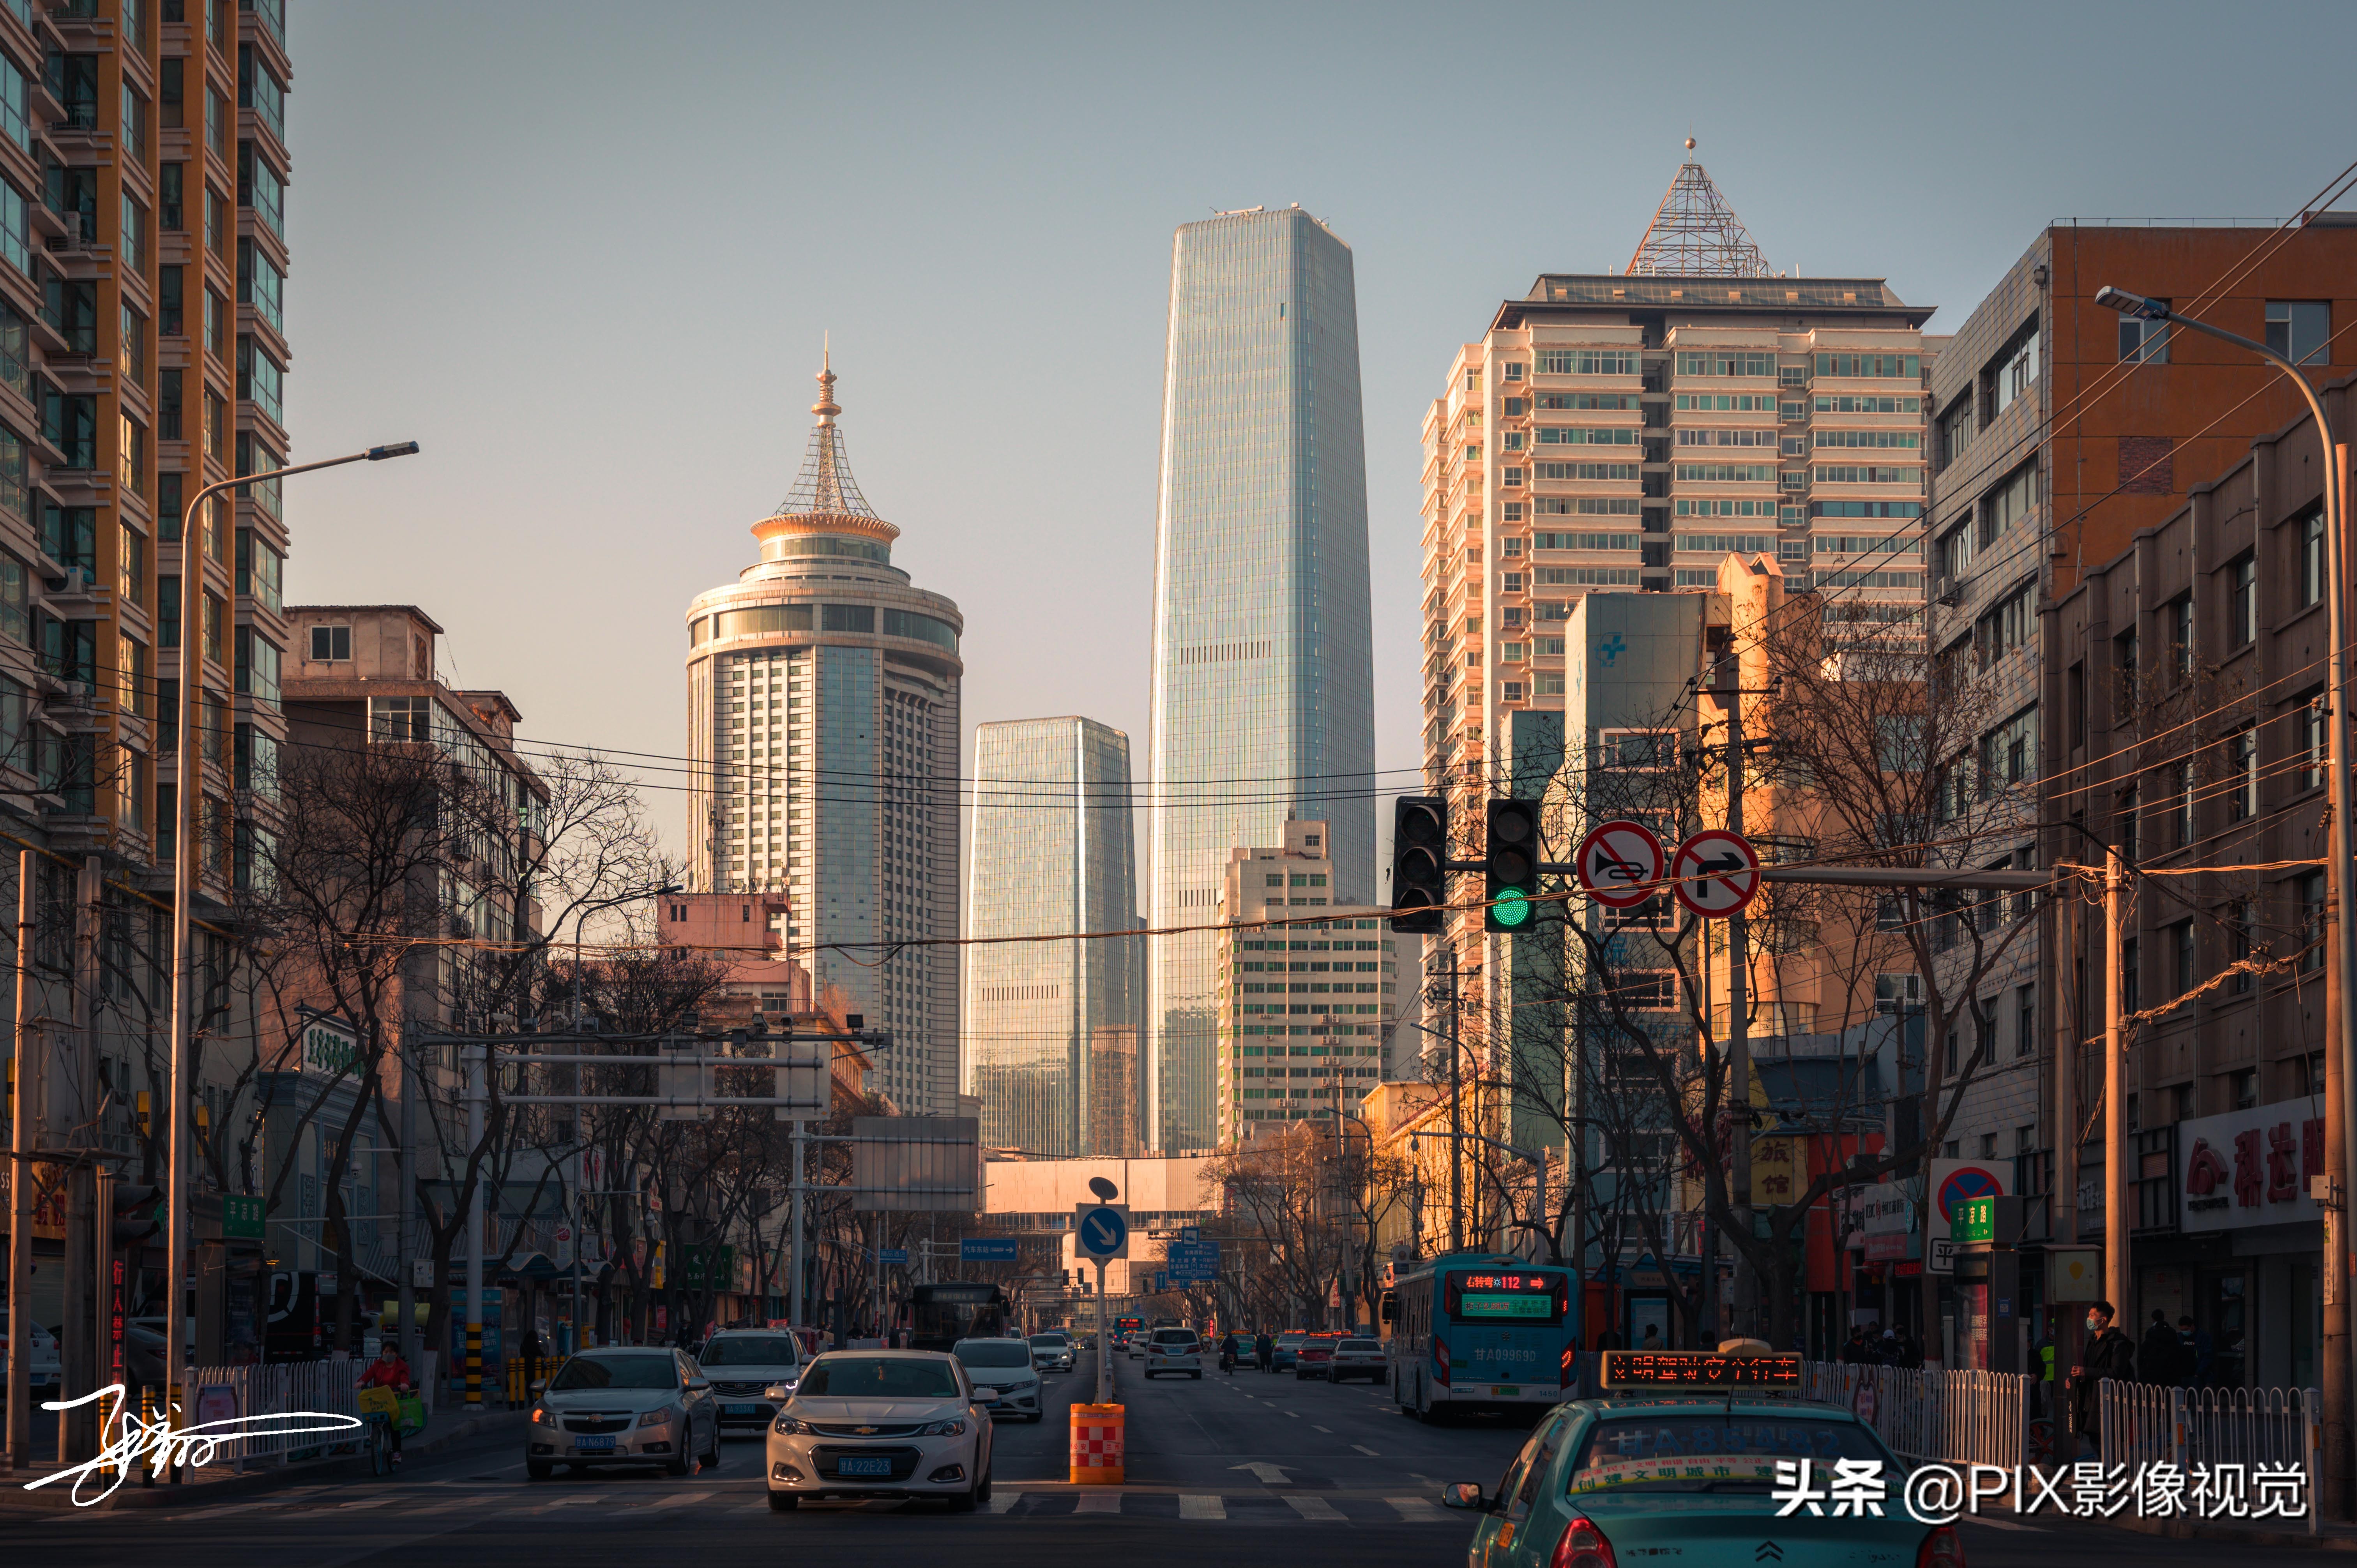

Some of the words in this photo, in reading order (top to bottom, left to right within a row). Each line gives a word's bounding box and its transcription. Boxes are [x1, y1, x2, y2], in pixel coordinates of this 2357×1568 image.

[1761, 1141, 1790, 1193] 旅馆
[229, 1201, 259, 1221] 平凉路
[1882, 1198, 1904, 1216] 中国工商银行
[1958, 1204, 1986, 1226] 平凉路
[1502, 1277, 1520, 1289] 112
[1465, 1302, 1509, 1310] 柜子2.58万
[1971, 1328, 1987, 1340] 美容医院
[1474, 1348, 1536, 1362] 甘A09969D
[577, 1437, 615, 1447] 甘A·N6879
[841, 1460, 889, 1472] 甘A·22E23
[1607, 1464, 1629, 1473] 民主
[1578, 1466, 1730, 1492] 创建文明城市
